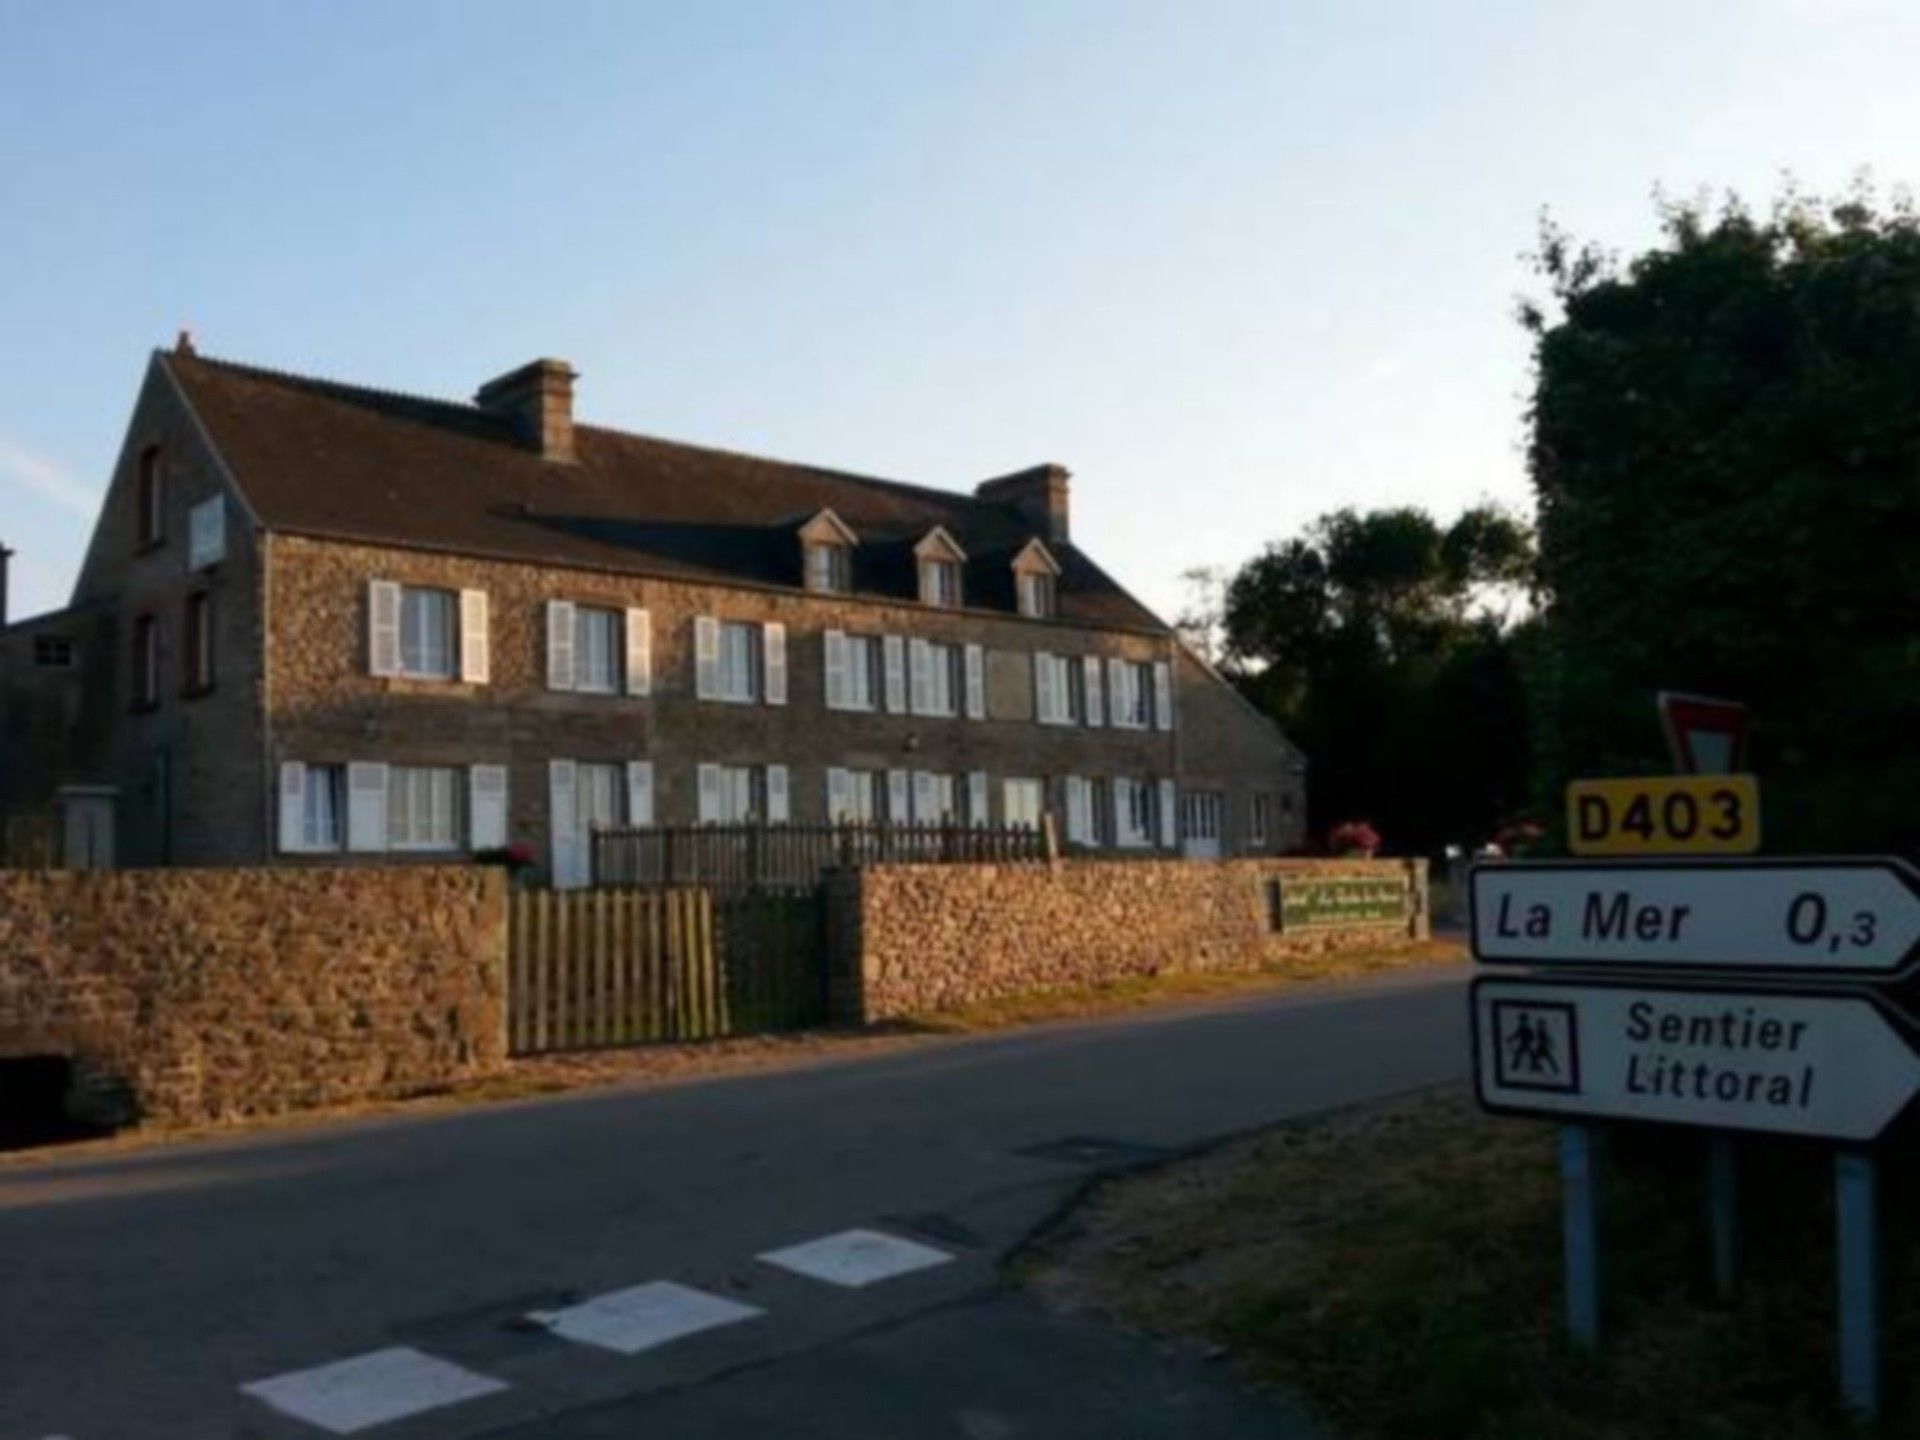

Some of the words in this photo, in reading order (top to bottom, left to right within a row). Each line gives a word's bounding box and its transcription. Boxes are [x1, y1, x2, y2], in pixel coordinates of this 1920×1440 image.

[1579, 792, 1743, 841] D403
[1496, 893, 1552, 938] La
[1582, 892, 1690, 941] Mer
[1786, 892, 1877, 952] 0,3
[1626, 1002, 1807, 1051] Sentier
[1626, 1055, 1814, 1107] Littoral
